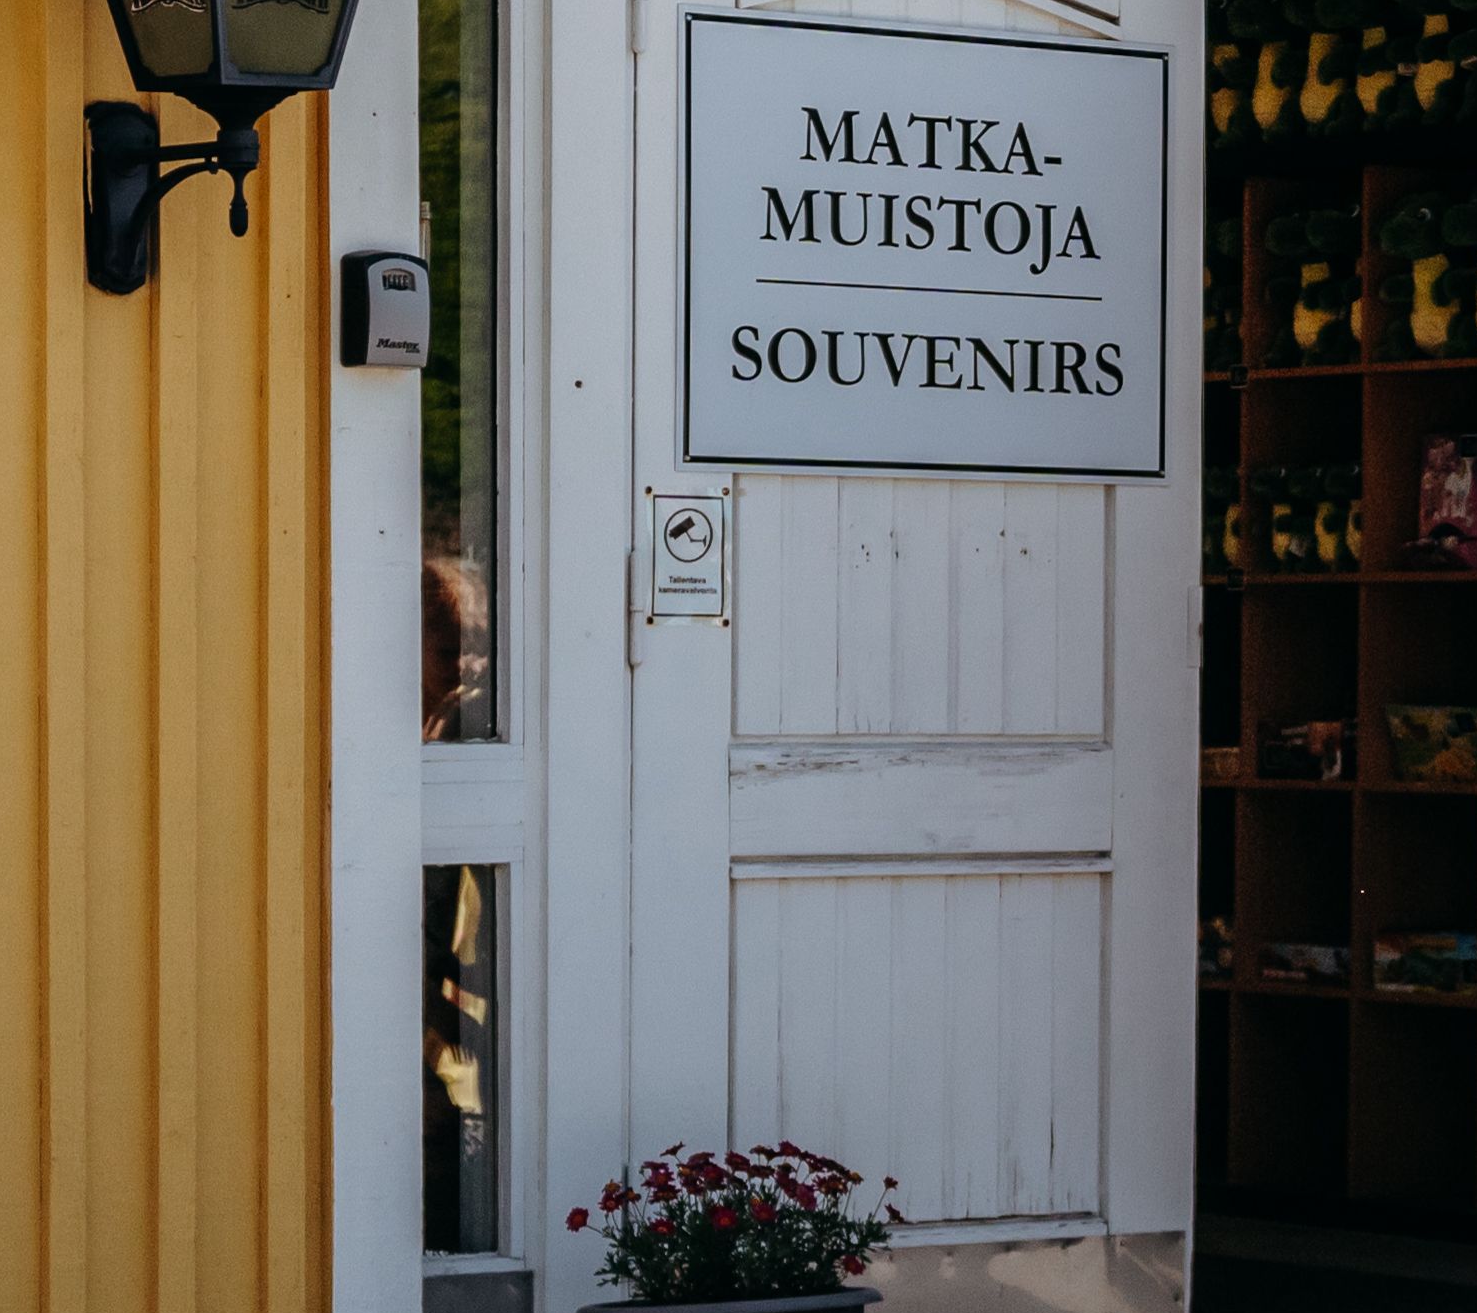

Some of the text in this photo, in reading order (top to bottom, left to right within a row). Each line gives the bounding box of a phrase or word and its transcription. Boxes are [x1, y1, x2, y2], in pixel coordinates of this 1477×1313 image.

[799, 107, 1063, 177] MATKA-
[760, 186, 1102, 275] MUISTOJA
[731, 324, 1125, 397] SOUVENIRS
